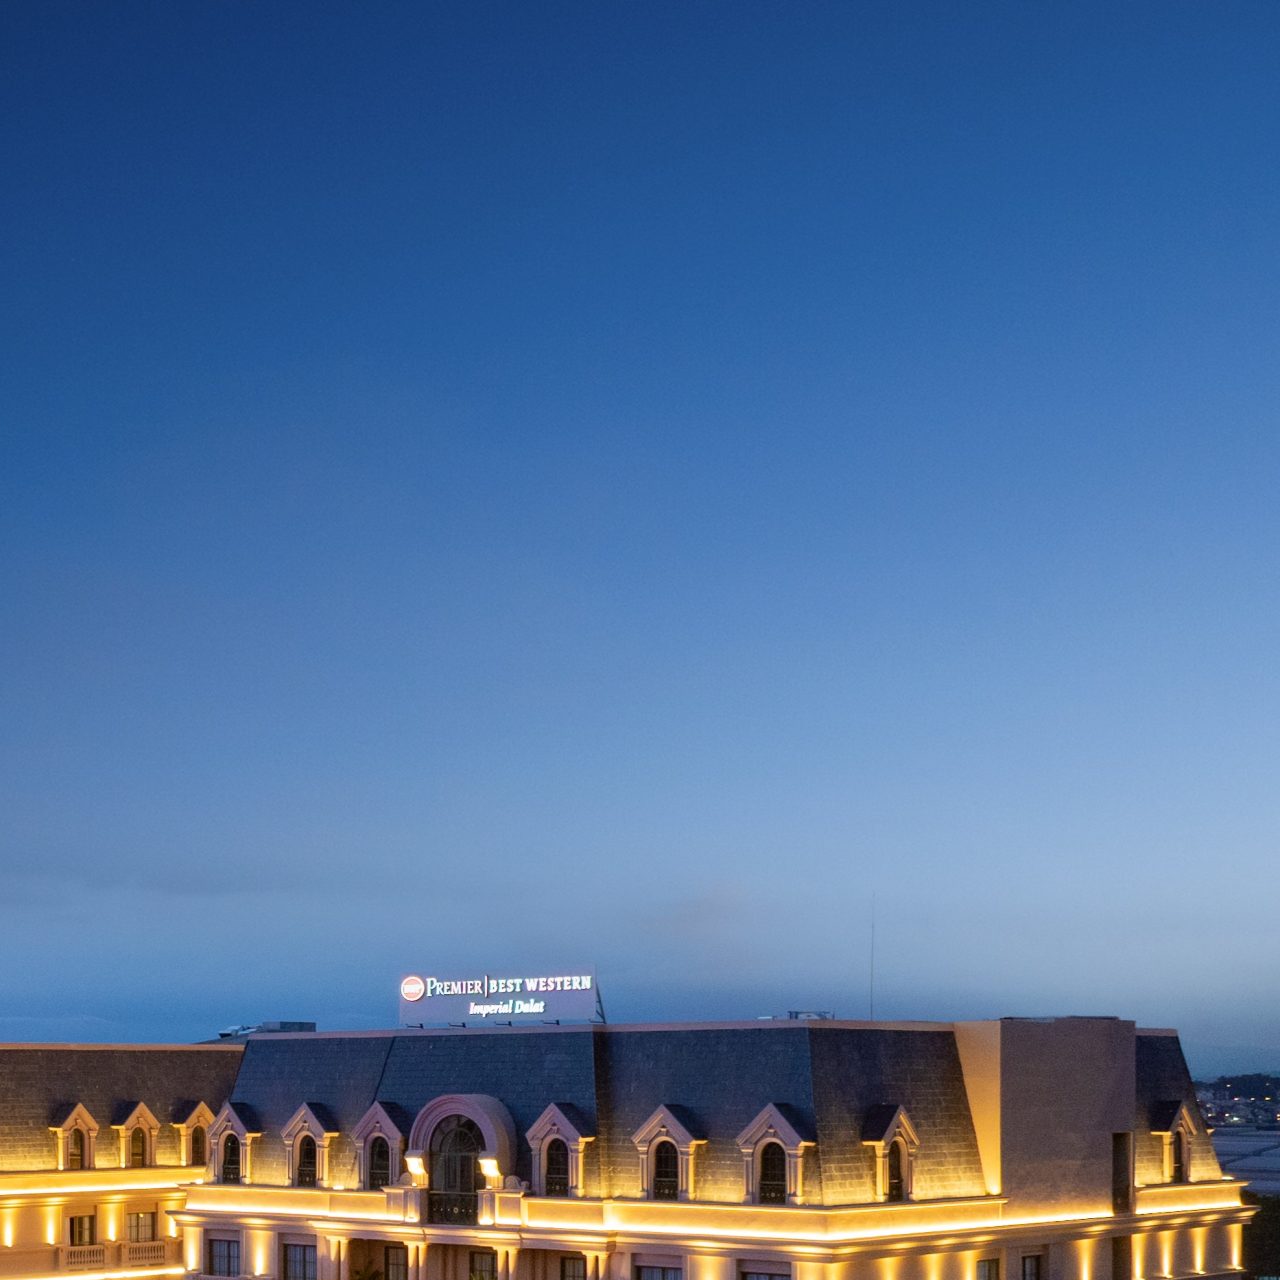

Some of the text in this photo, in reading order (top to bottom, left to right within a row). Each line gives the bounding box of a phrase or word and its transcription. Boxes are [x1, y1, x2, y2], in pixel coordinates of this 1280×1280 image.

[489, 978, 523, 994] BEST
[526, 976, 592, 991] WESTERN
[469, 998, 545, 1017] Imperial Dalat
